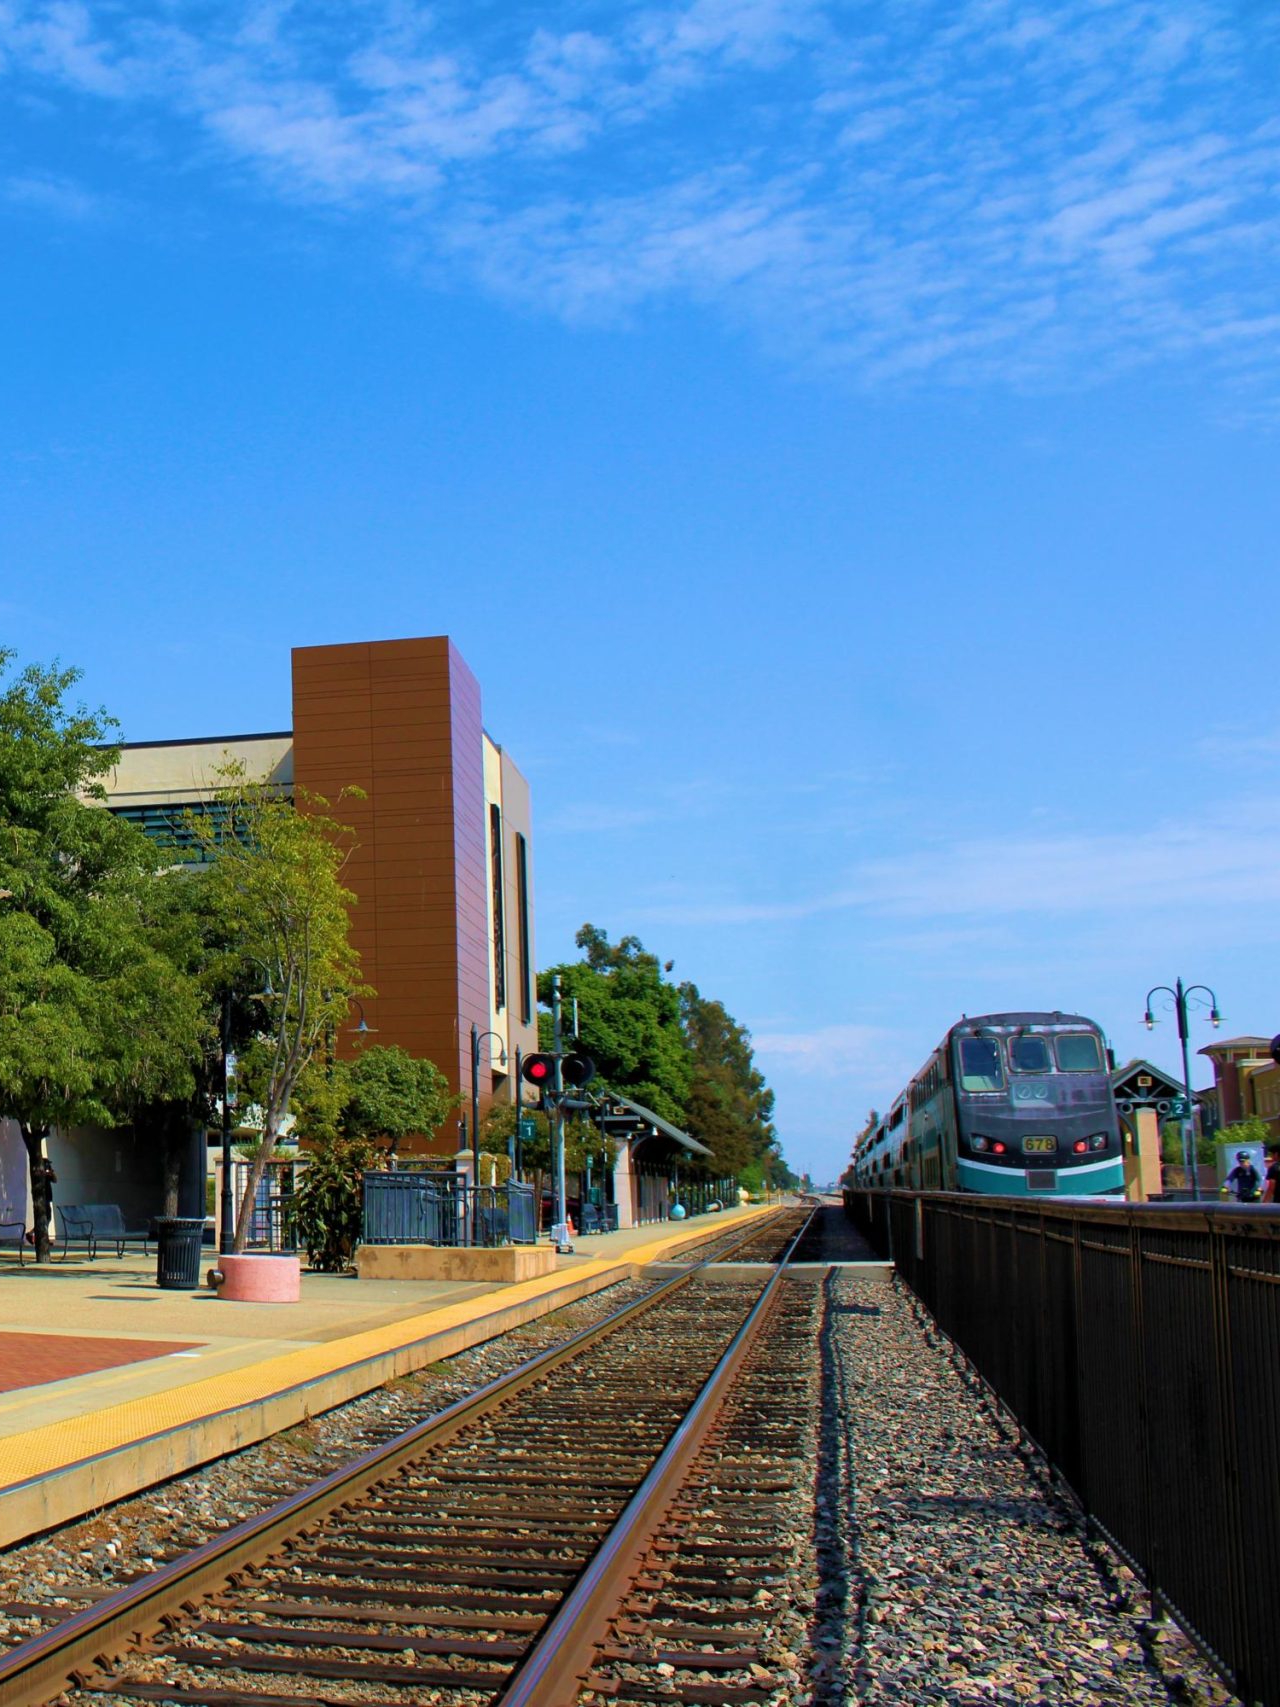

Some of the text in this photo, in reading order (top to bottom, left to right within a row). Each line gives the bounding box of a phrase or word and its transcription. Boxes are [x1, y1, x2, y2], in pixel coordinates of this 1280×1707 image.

[1175, 1104, 1184, 1114] 2
[525, 1126, 532, 1136] 1
[1025, 1138, 1054, 1151] 678
